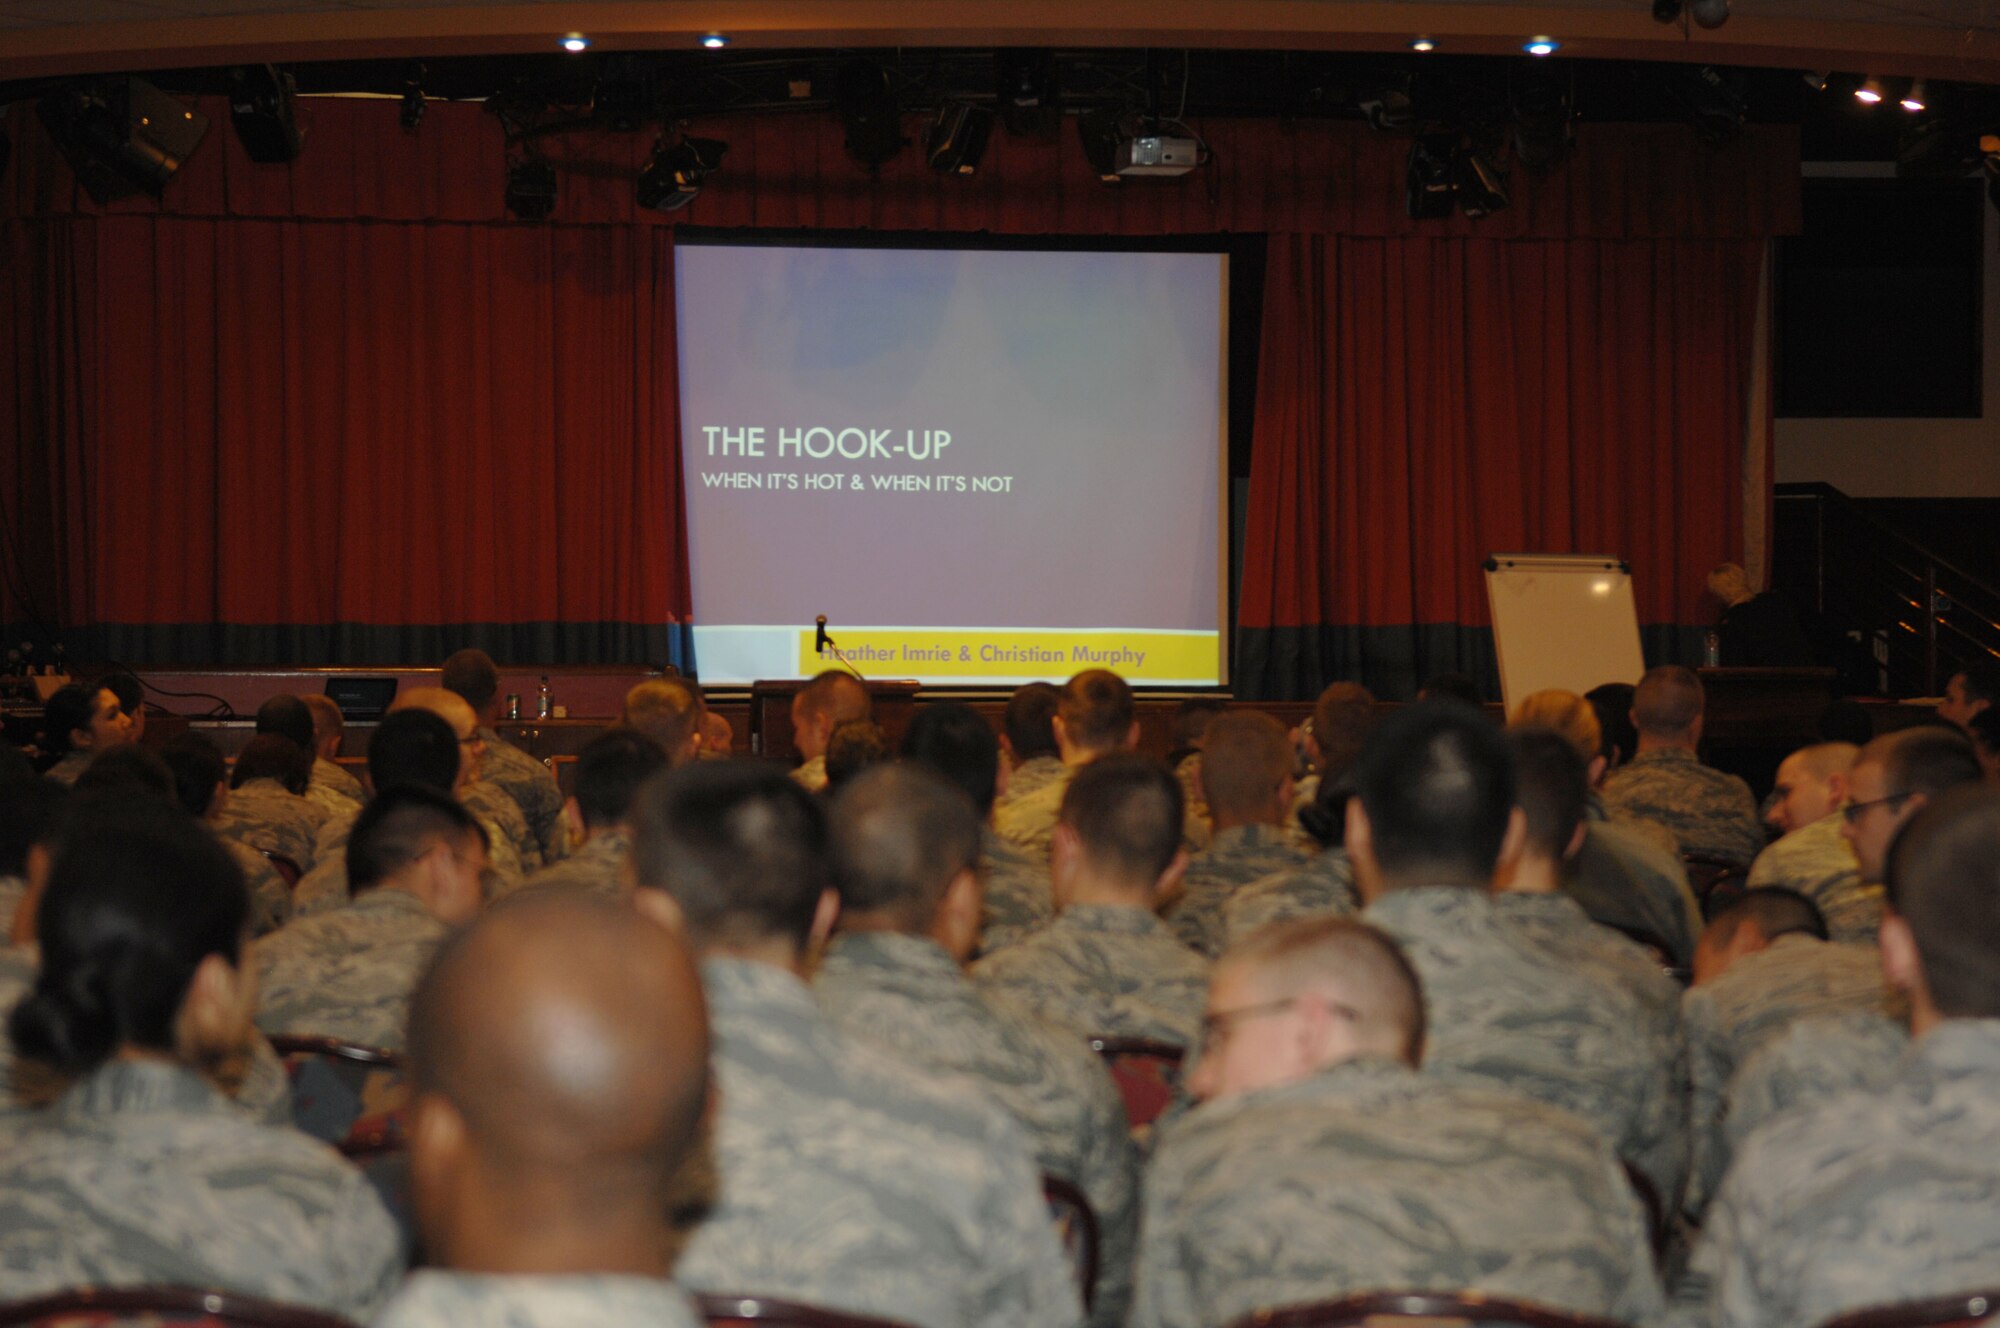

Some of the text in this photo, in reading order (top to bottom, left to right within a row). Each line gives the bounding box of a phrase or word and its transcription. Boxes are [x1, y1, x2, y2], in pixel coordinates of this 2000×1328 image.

[702, 426, 952, 461] THE HOOK-UP
[701, 472, 1014, 493] WHEN IT'S HOT & WHEN IT'S NOT
[902, 643, 953, 662] Imrie
[958, 645, 973, 662] &
[978, 643, 1065, 663] Christian
[1071, 644, 1146, 667] Murphy
